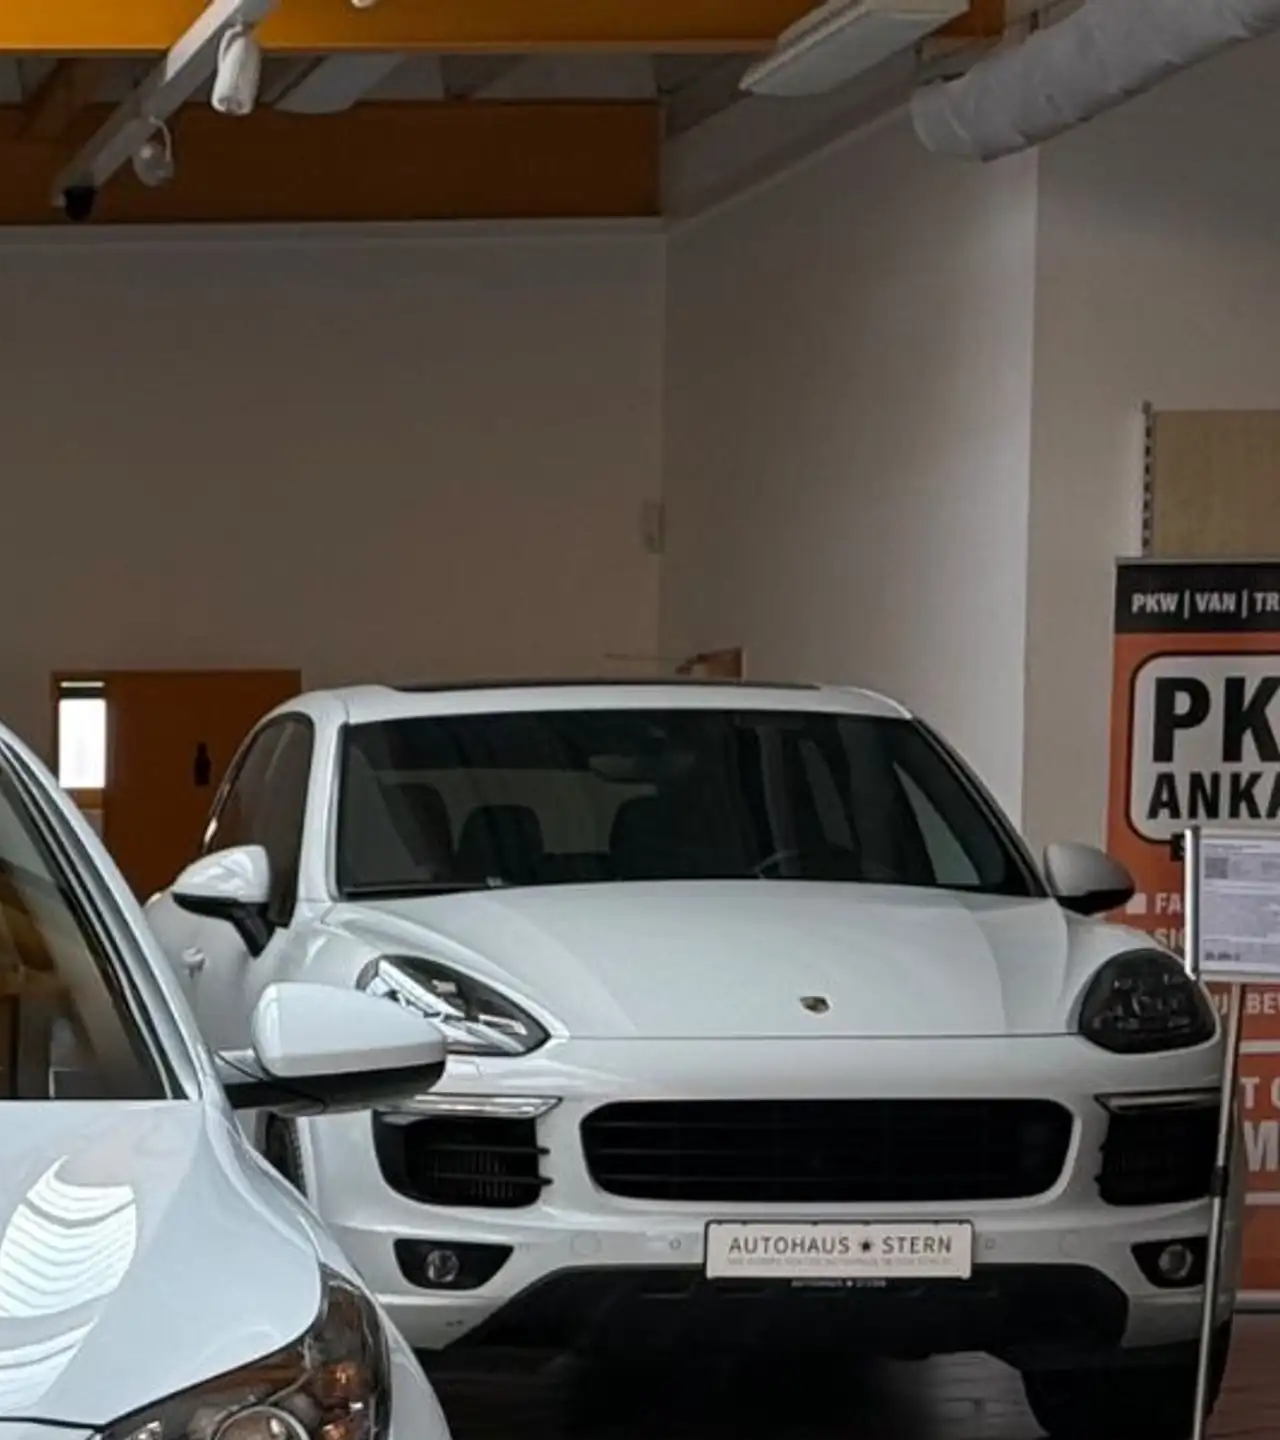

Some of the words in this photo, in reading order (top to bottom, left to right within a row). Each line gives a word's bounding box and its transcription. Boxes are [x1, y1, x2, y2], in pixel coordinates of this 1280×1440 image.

[1131, 592, 1179, 613] PKW
[1195, 592, 1236, 613] VAN
[728, 1236, 850, 1255] AUTOHAUS
[881, 1235, 952, 1255] STERN
